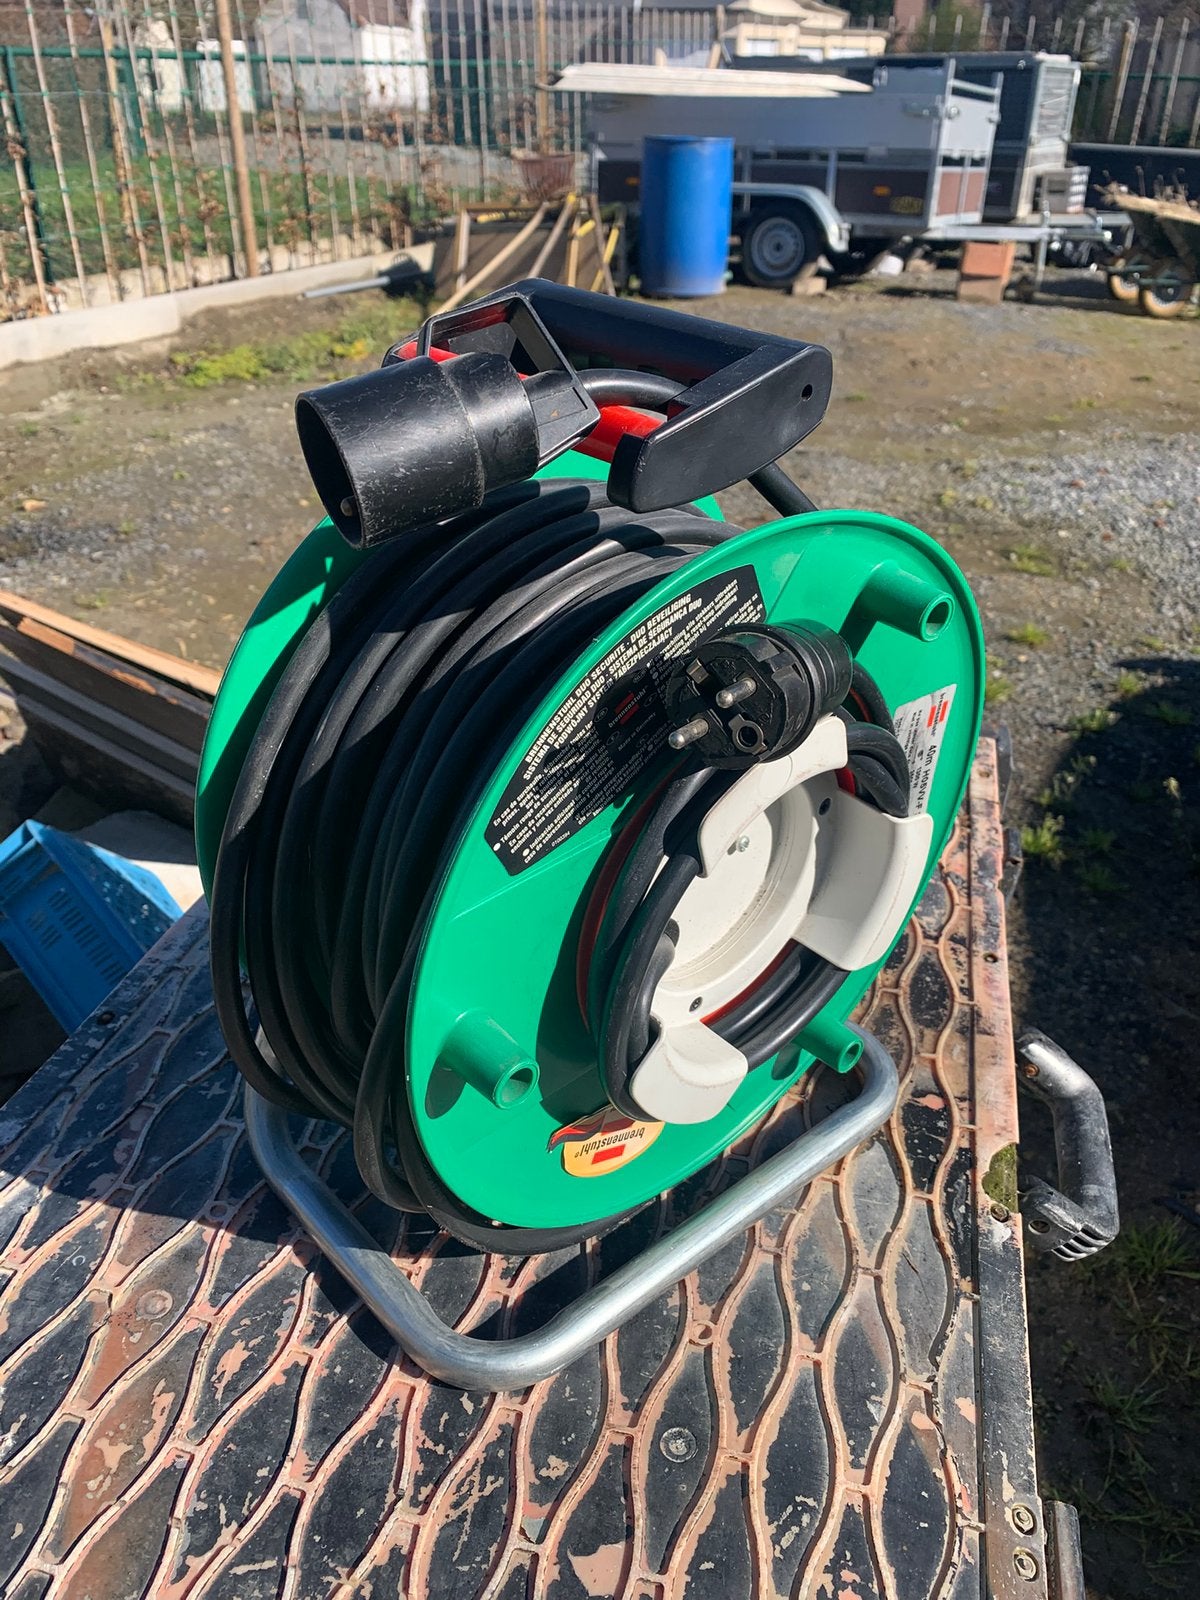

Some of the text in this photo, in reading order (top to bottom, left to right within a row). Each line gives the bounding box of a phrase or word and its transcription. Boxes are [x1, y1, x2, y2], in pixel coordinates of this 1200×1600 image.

[523, 744, 549, 780] SISTEMA
[546, 731, 558, 744] DE
[555, 690, 591, 732] SEGURIDAD
[589, 675, 605, 692] DUO
[608, 644, 638, 674] SISTEMA
[637, 634, 647, 648] DE
[648, 607, 687, 639] SEGURANÇA
[687, 597, 702, 612] DUO
[525, 696, 576, 762] BRENNENSTUHL
[574, 677, 591, 697] DUO
[590, 643, 625, 680] SECURITE
[629, 625, 646, 643] DUO
[646, 593, 691, 629] BEVEILIGING
[553, 627, 672, 749] PODWÓJNY SYSTEM ZABEZPIECZAJĄCY
[492, 816, 502, 826] En
[499, 806, 511, 819] cas
[508, 799, 518, 809] de
[516, 772, 544, 802] surchauffe,
[524, 798, 534, 810] sur
[532, 793, 541, 801] le
[915, 744, 937, 809] 40m H05VV-F
[499, 822, 520, 843] Témoin
[518, 807, 534, 824] rouge
[532, 800, 541, 810] de
[501, 807, 520, 827] prises,
[516, 790, 534, 808] après
[507, 837, 517, 847] En
[515, 825, 528, 840] caso
[527, 818, 535, 827] de
[534, 779, 572, 820] recalentamiento
[509, 829, 533, 854] enchufes
[530, 824, 537, 832] y
[534, 815, 546, 827] una
[544, 805, 554, 817] vez
[552, 786, 574, 808] enfriado
[528, 822, 555, 849] Indicación
[553, 798, 575, 824] adicional
[523, 849, 536, 863] caso
[533, 840, 543, 851] de
